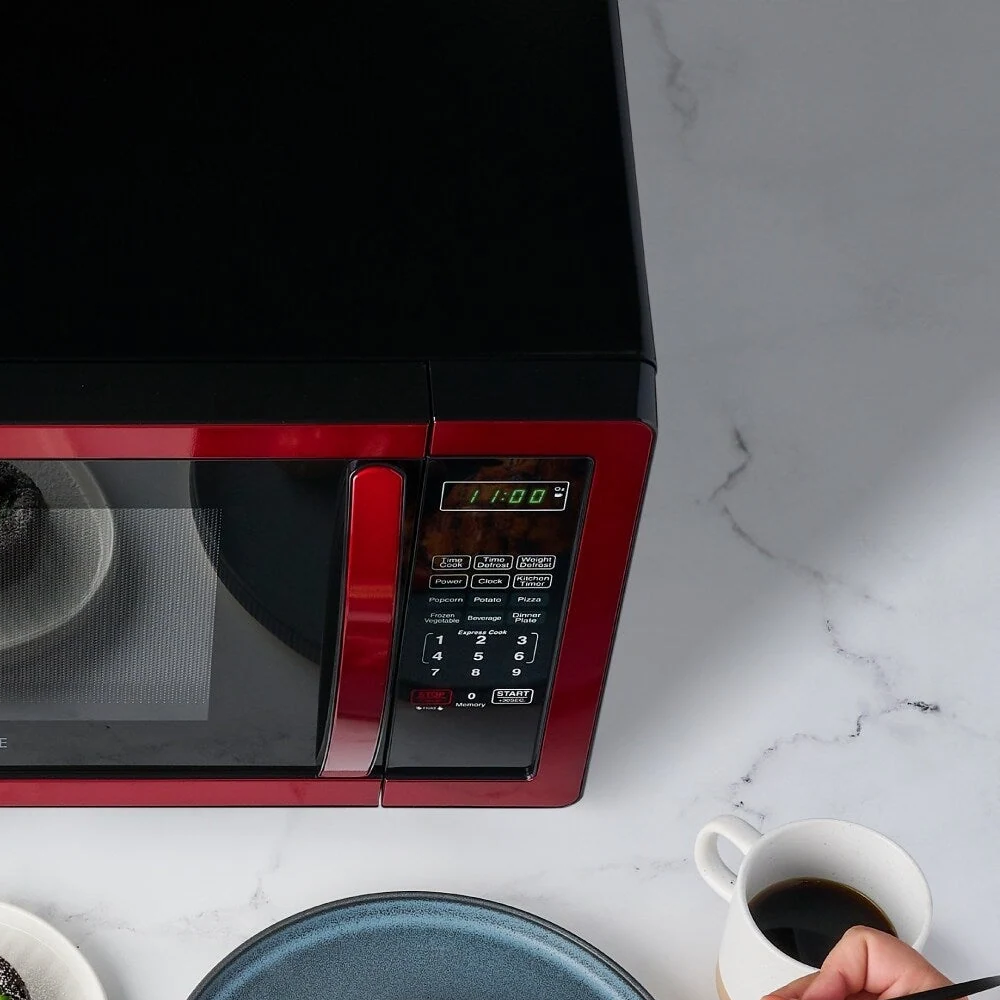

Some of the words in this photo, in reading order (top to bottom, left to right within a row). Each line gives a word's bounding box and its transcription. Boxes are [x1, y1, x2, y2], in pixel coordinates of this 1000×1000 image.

[470, 489, 546, 504] 11:00
[435, 635, 444, 645] 1
[475, 635, 487, 645] 2
[516, 635, 528, 645] 3
[431, 651, 443, 661] 4
[473, 651, 484, 661] 5
[513, 651, 525, 661] 6
[430, 668, 440, 676] 7
[470, 668, 481, 677] 8
[511, 668, 522, 677] 9
[418, 691, 446, 699] STOP
[467, 692, 476, 700] 0
